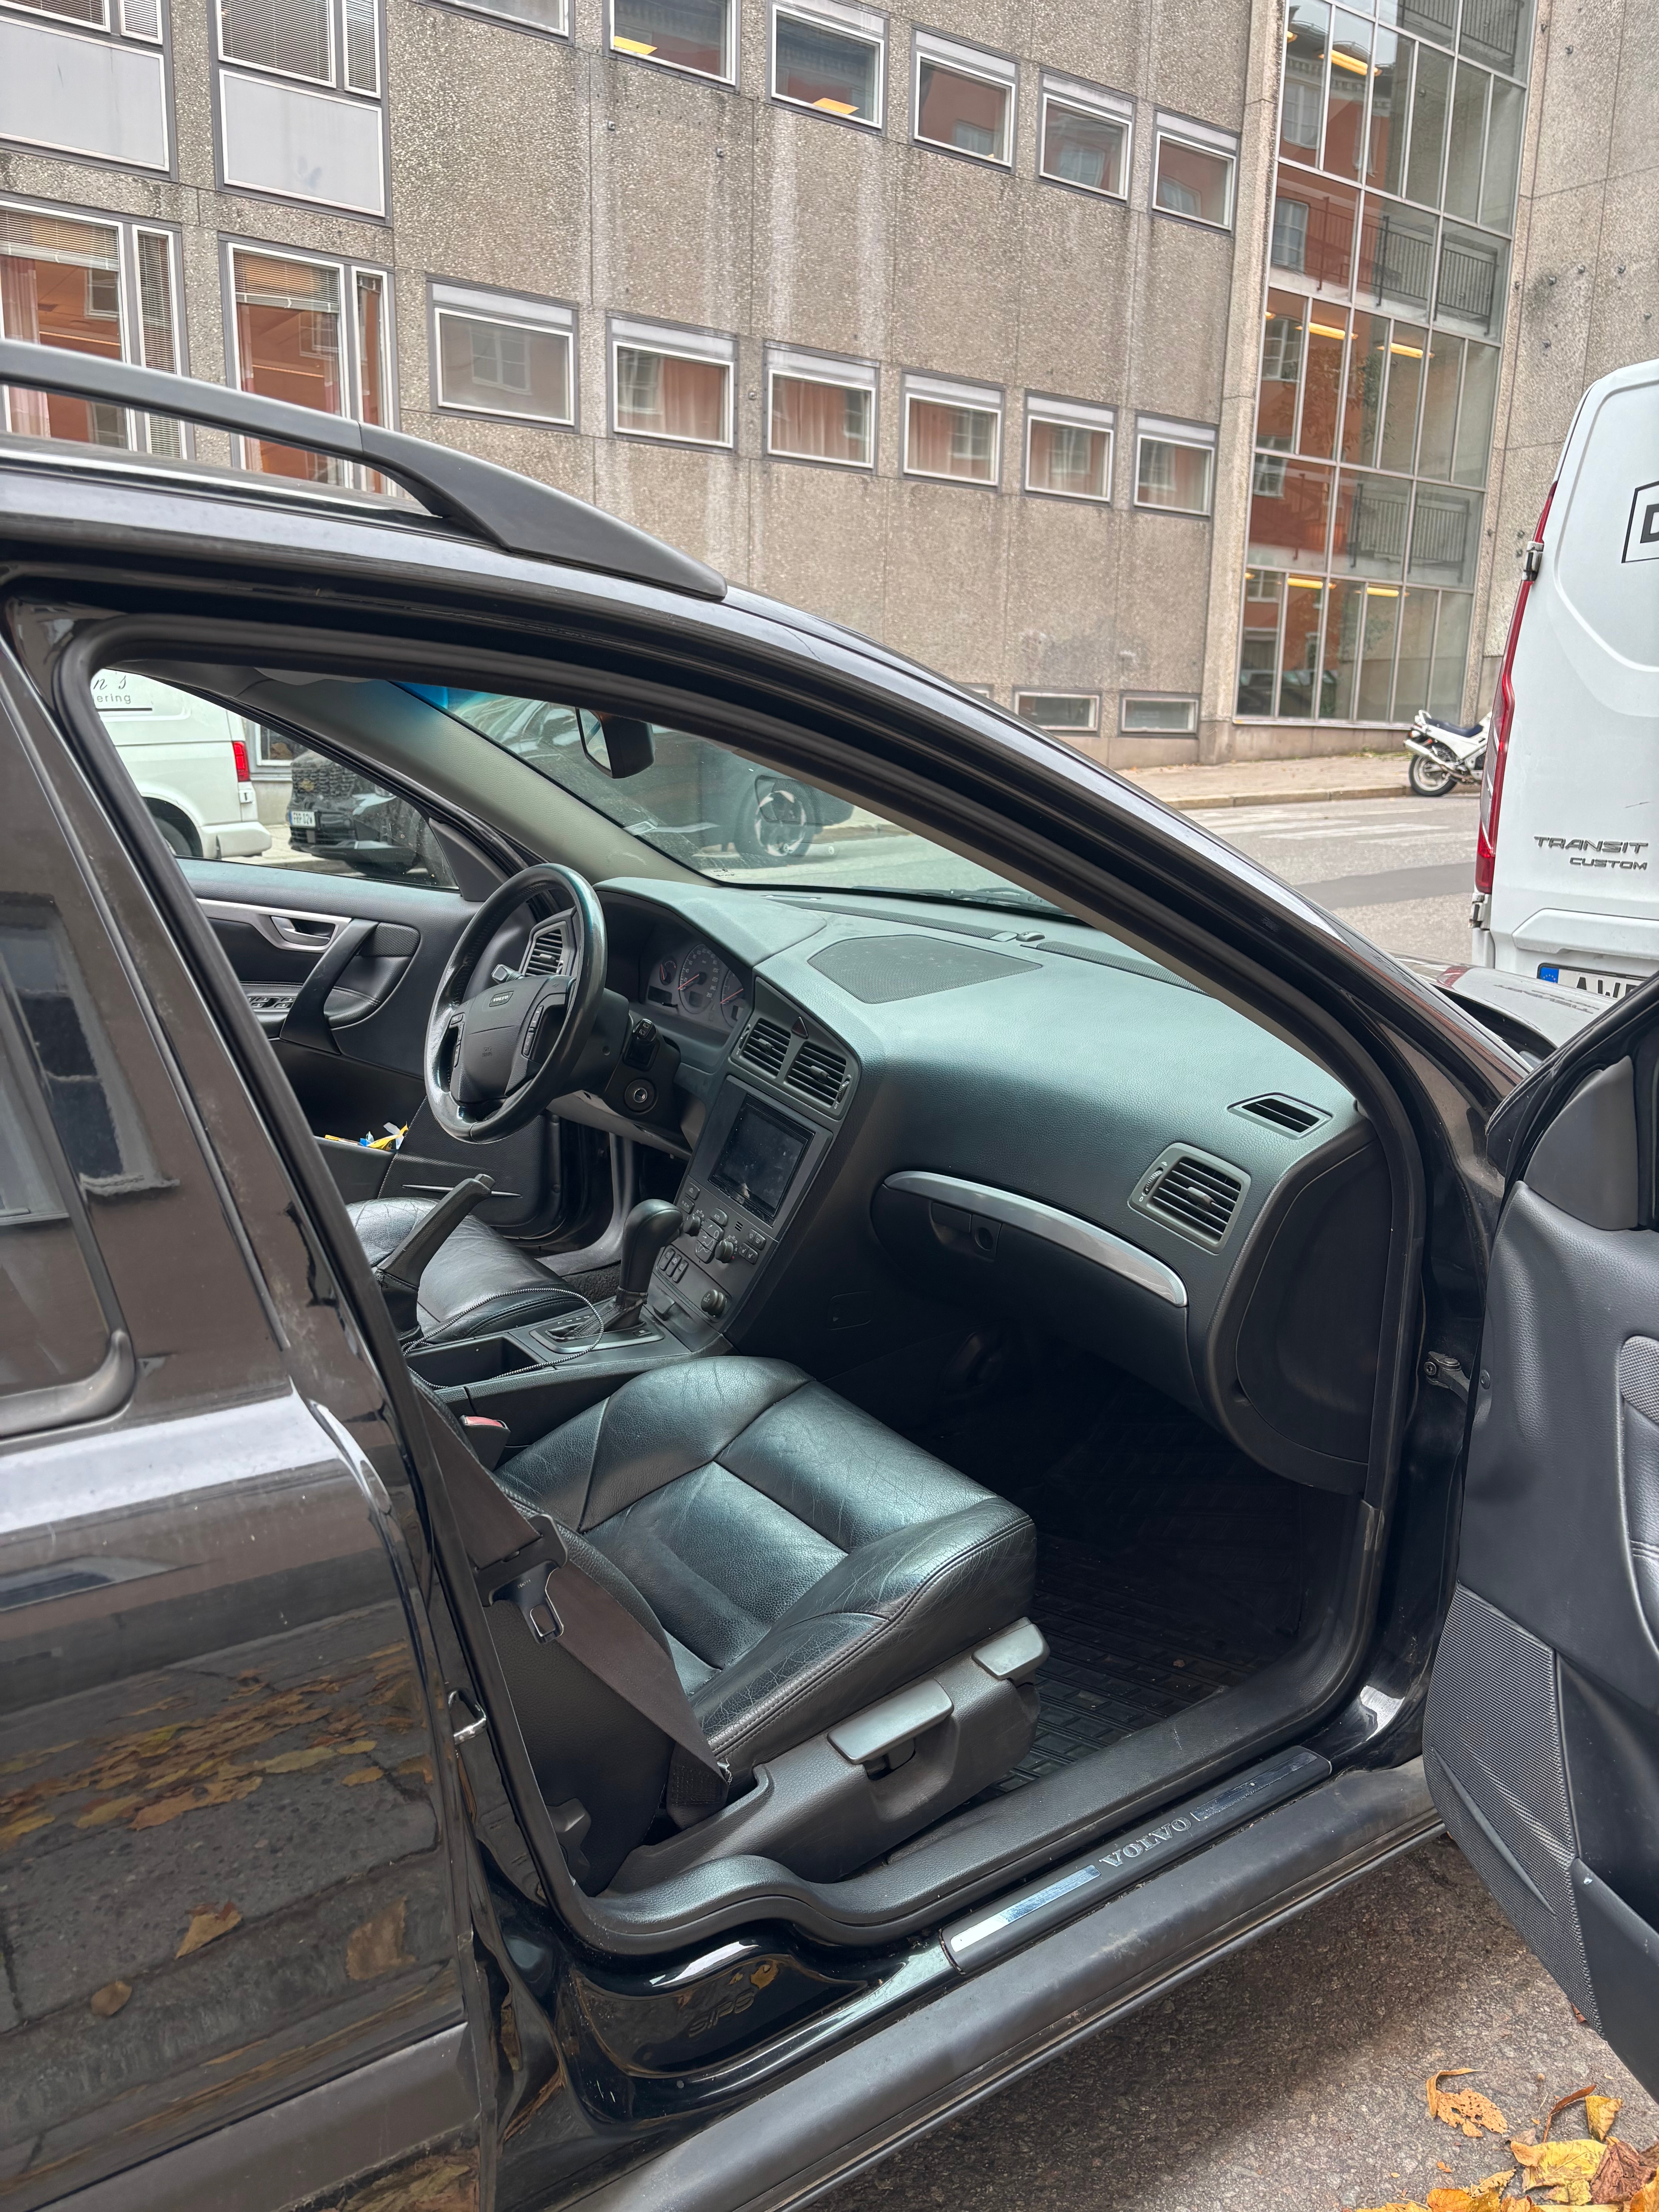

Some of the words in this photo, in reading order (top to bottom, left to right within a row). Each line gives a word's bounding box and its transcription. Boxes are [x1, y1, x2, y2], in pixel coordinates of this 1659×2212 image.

[93, 694, 131, 704] ering
[1534, 836, 1648, 853] TRANSIT
[1570, 857, 1647, 870] CUSTOM
[1099, 1817, 1191, 1867] VOLVO
[688, 1987, 755, 2038] SIPS
